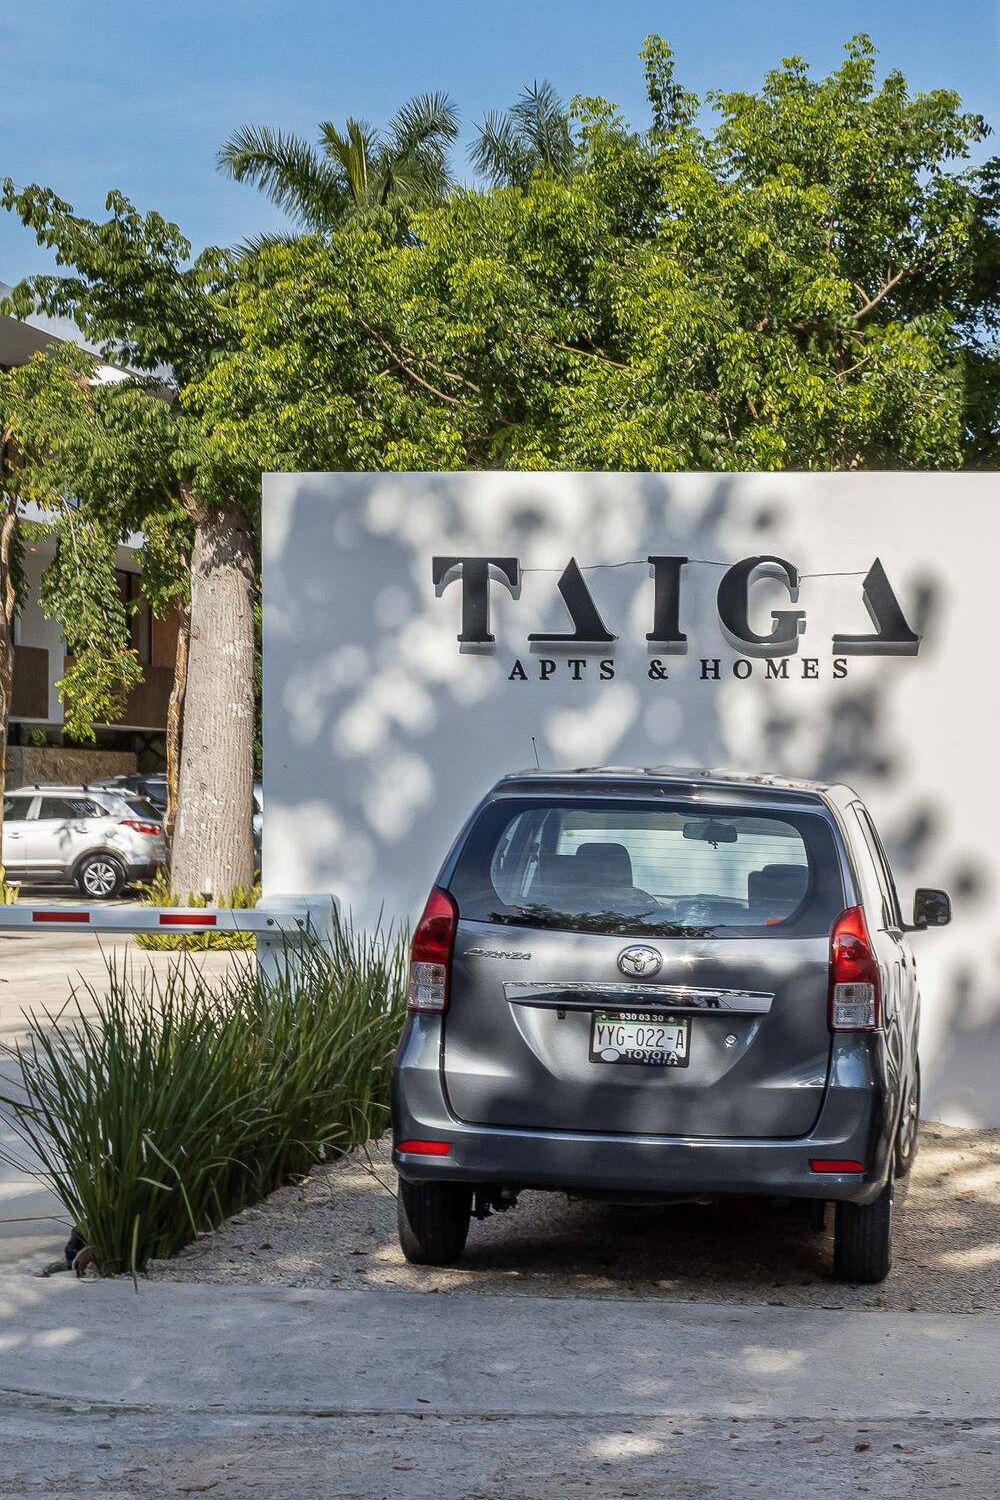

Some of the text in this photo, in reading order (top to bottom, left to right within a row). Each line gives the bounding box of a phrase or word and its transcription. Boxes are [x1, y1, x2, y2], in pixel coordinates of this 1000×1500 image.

[432, 555, 920, 646] TAIGA
[507, 658, 849, 681] APTS & HOMES
[619, 1012, 637, 1021] 930
[596, 1024, 685, 1049] YYG-022-A
[626, 1049, 679, 1061] TOYOTA
